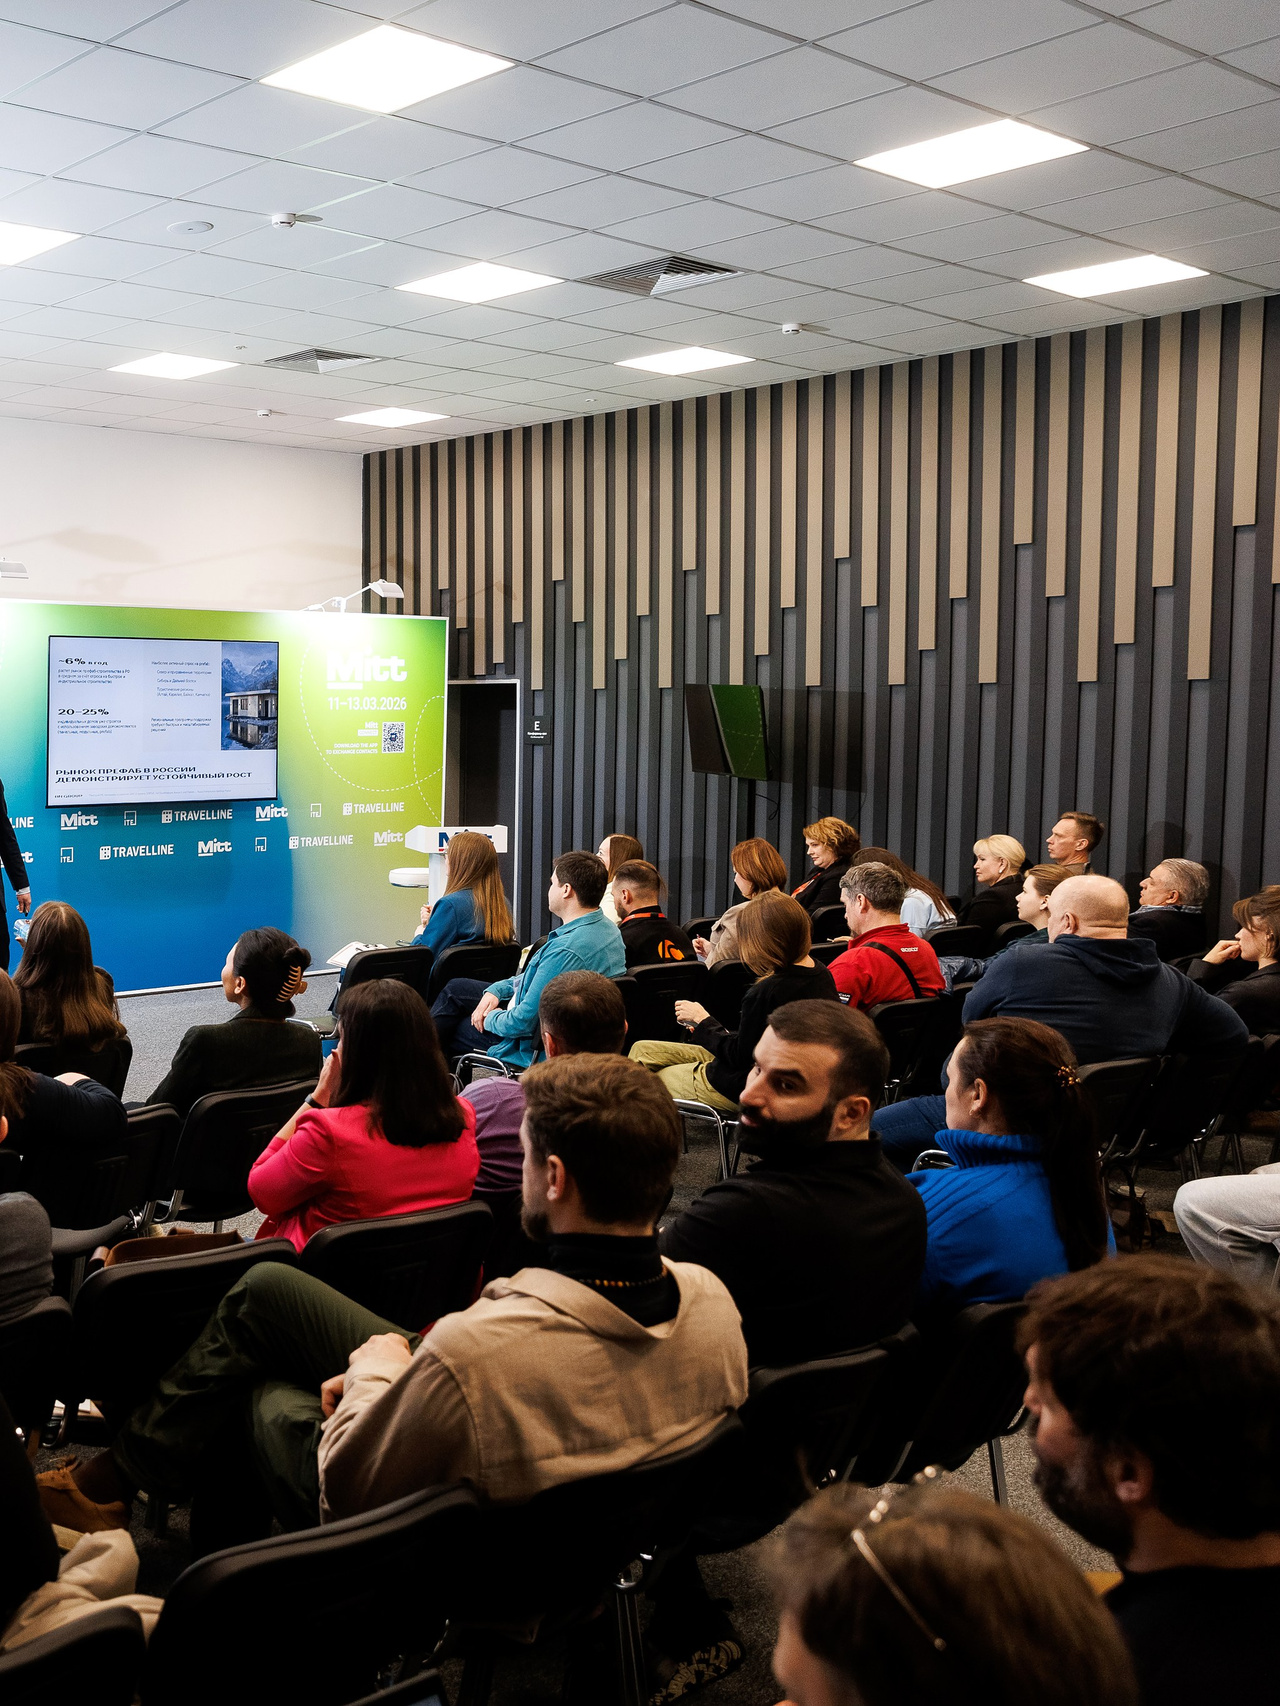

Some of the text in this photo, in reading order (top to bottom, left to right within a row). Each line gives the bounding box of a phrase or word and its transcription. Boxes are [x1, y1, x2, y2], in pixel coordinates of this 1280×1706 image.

[58, 657, 86, 666] ~6%
[326, 646, 408, 682] Mitt
[534, 720, 540, 731] E
[55, 774, 151, 784] ДЕМОНСТРИРУЕТ
[153, 772, 225, 782] УСТОЙЧИВЫЙ
[56, 768, 96, 776] РЫНОК
[174, 808, 233, 822] TRAVELLINE
[256, 804, 288, 818] Mitt
[354, 802, 404, 814] TRAVELLINE
[60, 811, 99, 827] Mitt
[300, 834, 354, 847] TRAVELLINE
[374, 830, 404, 844] Mitt
[113, 844, 174, 858] TRAVELLINE
[198, 838, 232, 854] Mitt
